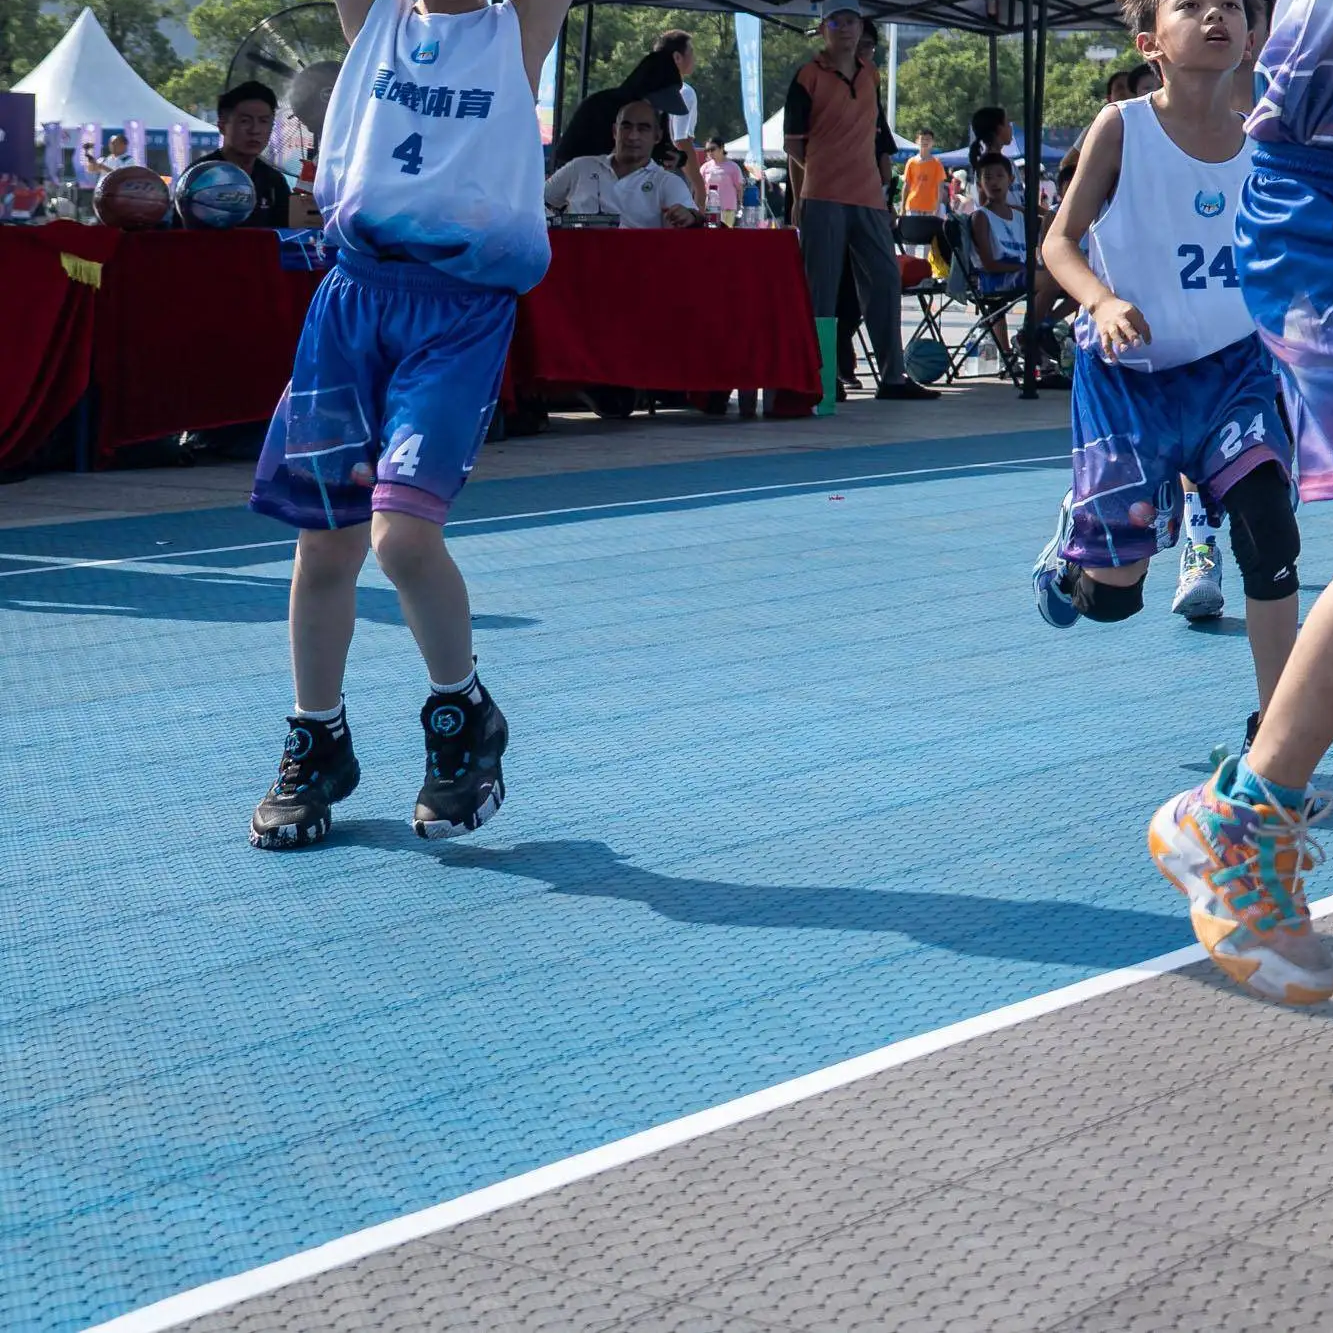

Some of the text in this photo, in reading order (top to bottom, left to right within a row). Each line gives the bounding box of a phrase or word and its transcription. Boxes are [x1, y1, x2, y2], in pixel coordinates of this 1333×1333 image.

[391, 131, 424, 176] 4
[1178, 243, 1241, 291] 24
[390, 433, 425, 478] 4
[1218, 412, 1267, 460] 24
